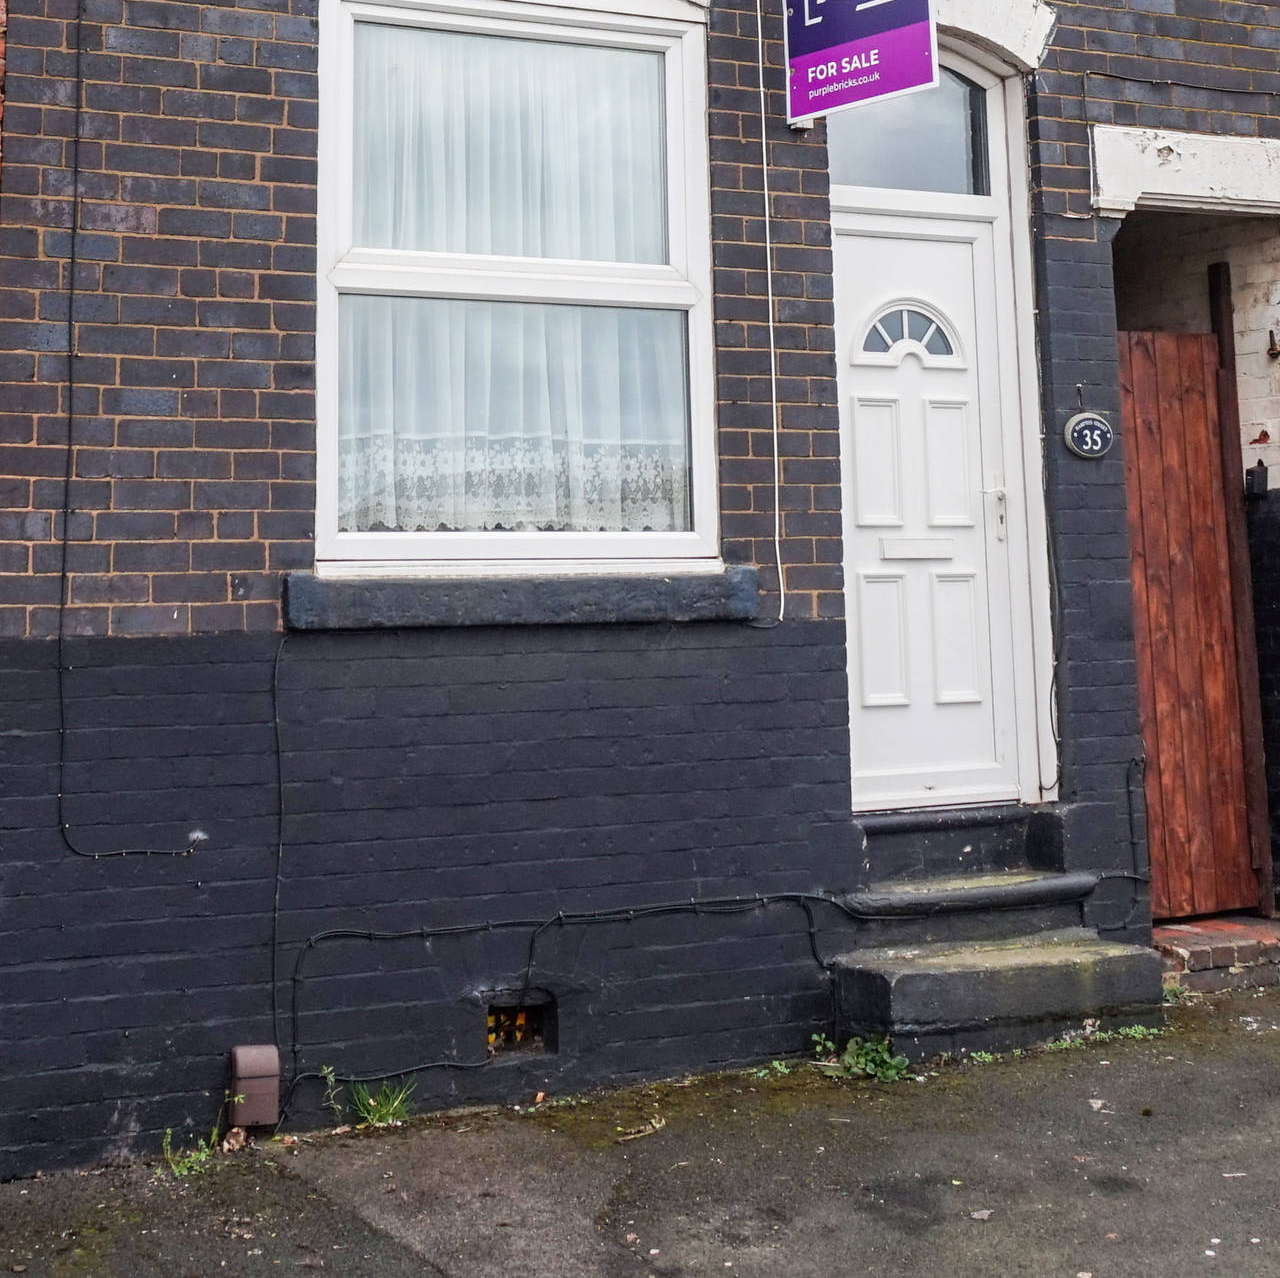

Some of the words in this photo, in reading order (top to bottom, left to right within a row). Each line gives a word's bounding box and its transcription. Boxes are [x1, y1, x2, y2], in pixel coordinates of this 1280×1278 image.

[807, 61, 838, 83] FOR
[841, 49, 880, 74] SALE
[808, 71, 880, 99] purplebricks.co.uk
[1082, 429, 1102, 450] 35
